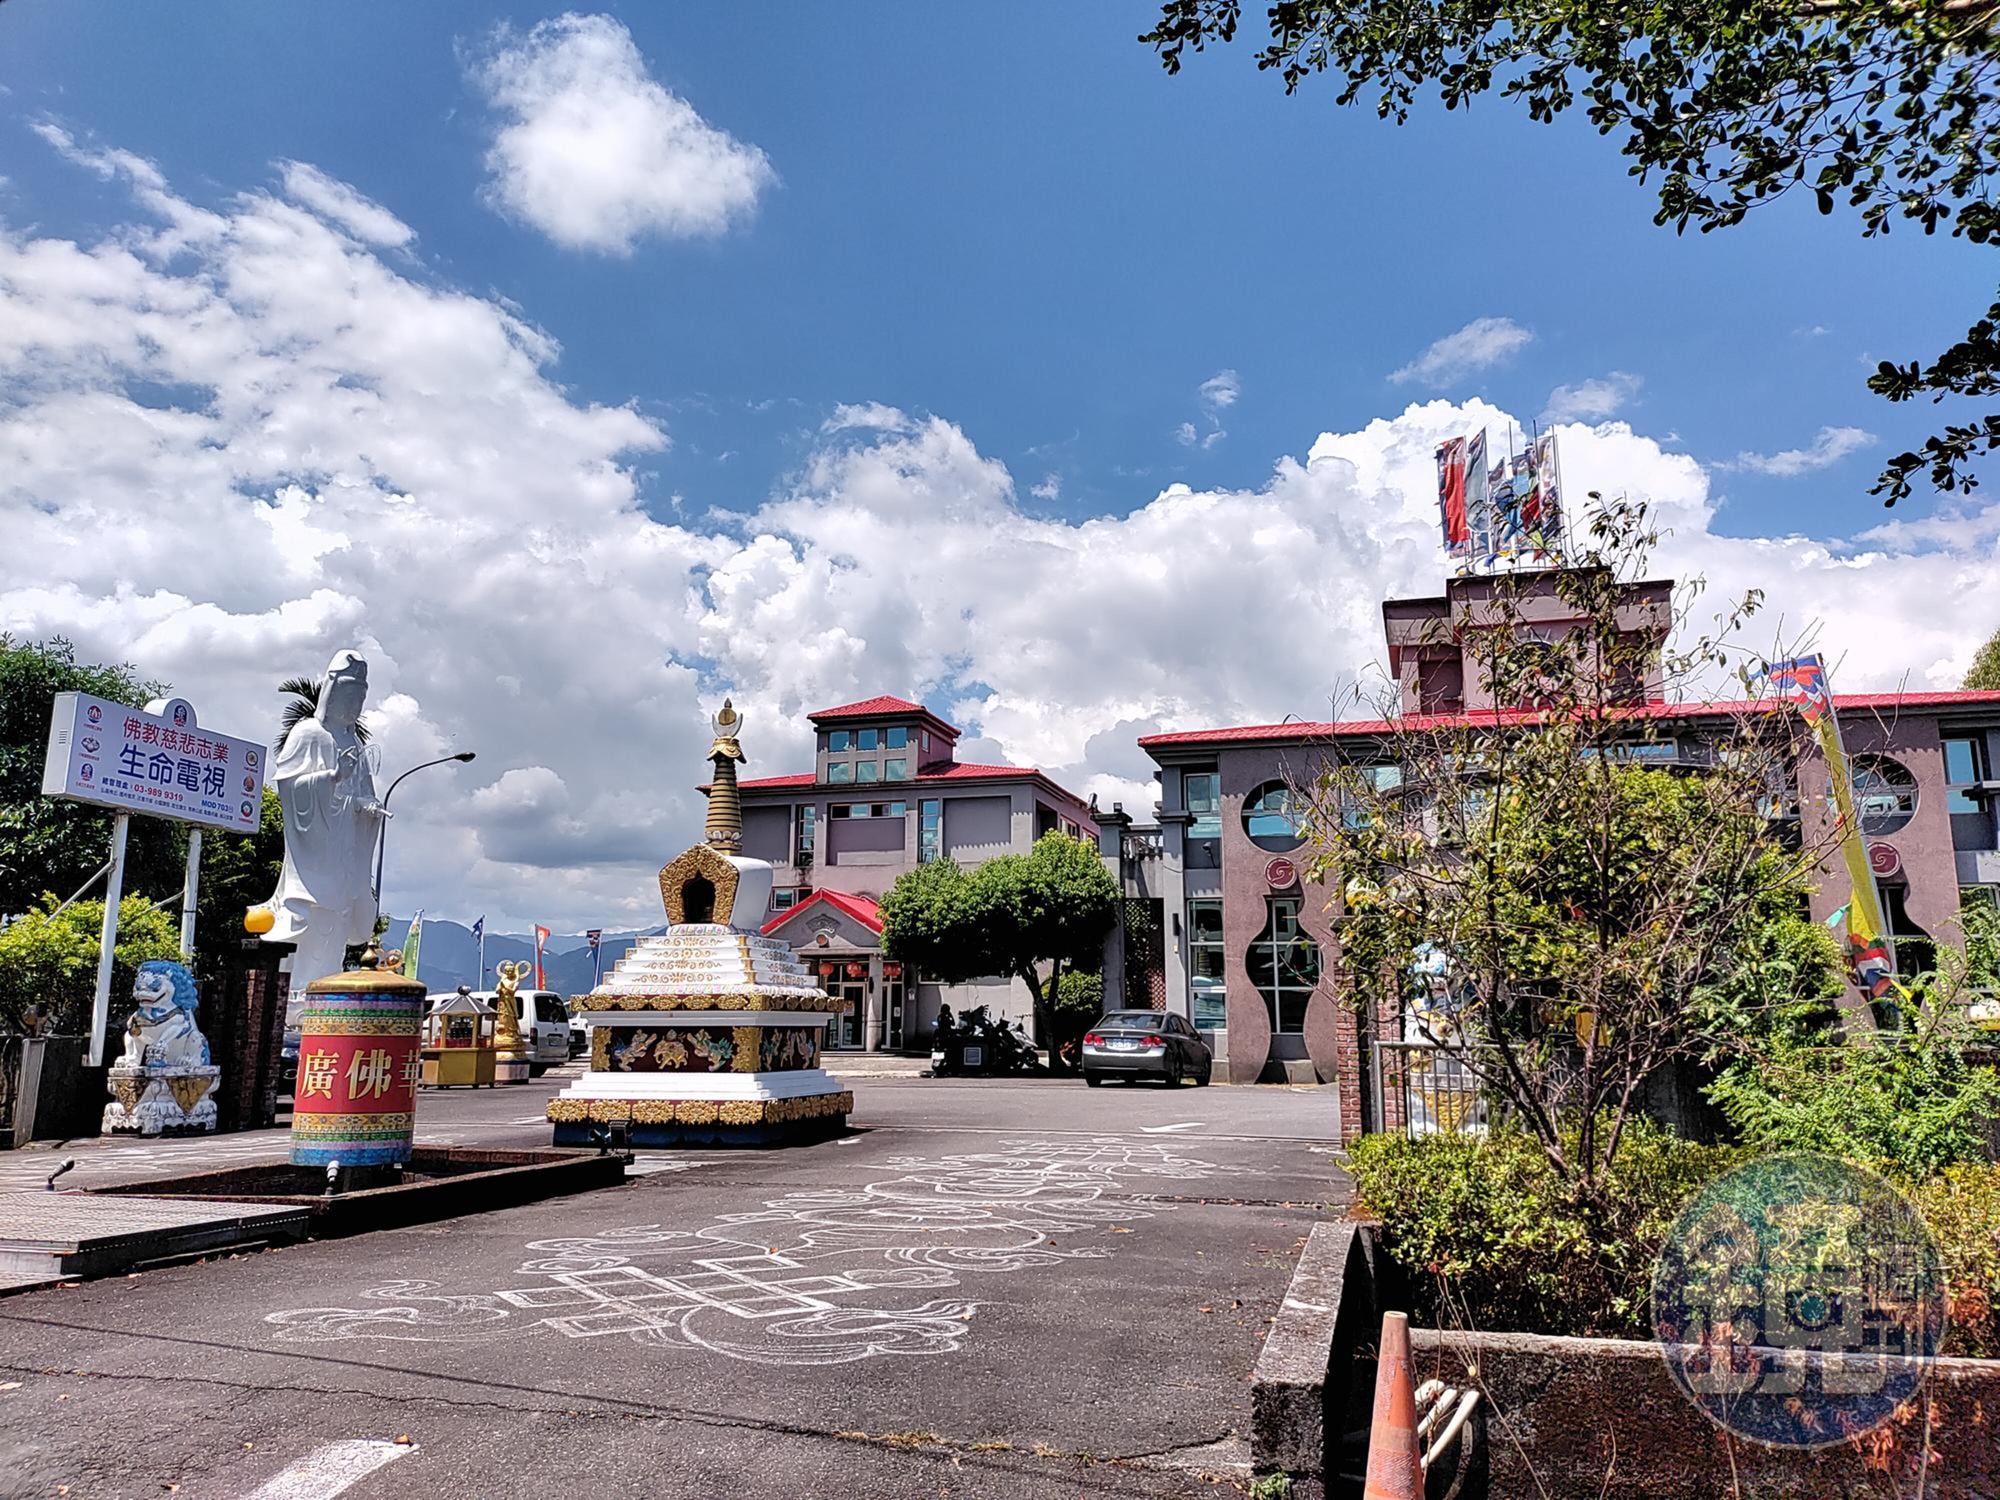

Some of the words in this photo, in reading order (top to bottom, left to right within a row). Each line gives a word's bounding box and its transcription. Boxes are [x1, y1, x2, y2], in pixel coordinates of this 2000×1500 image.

[123, 716, 229, 764] 佛教慈悲志業
[117, 743, 226, 798] 生命電視
